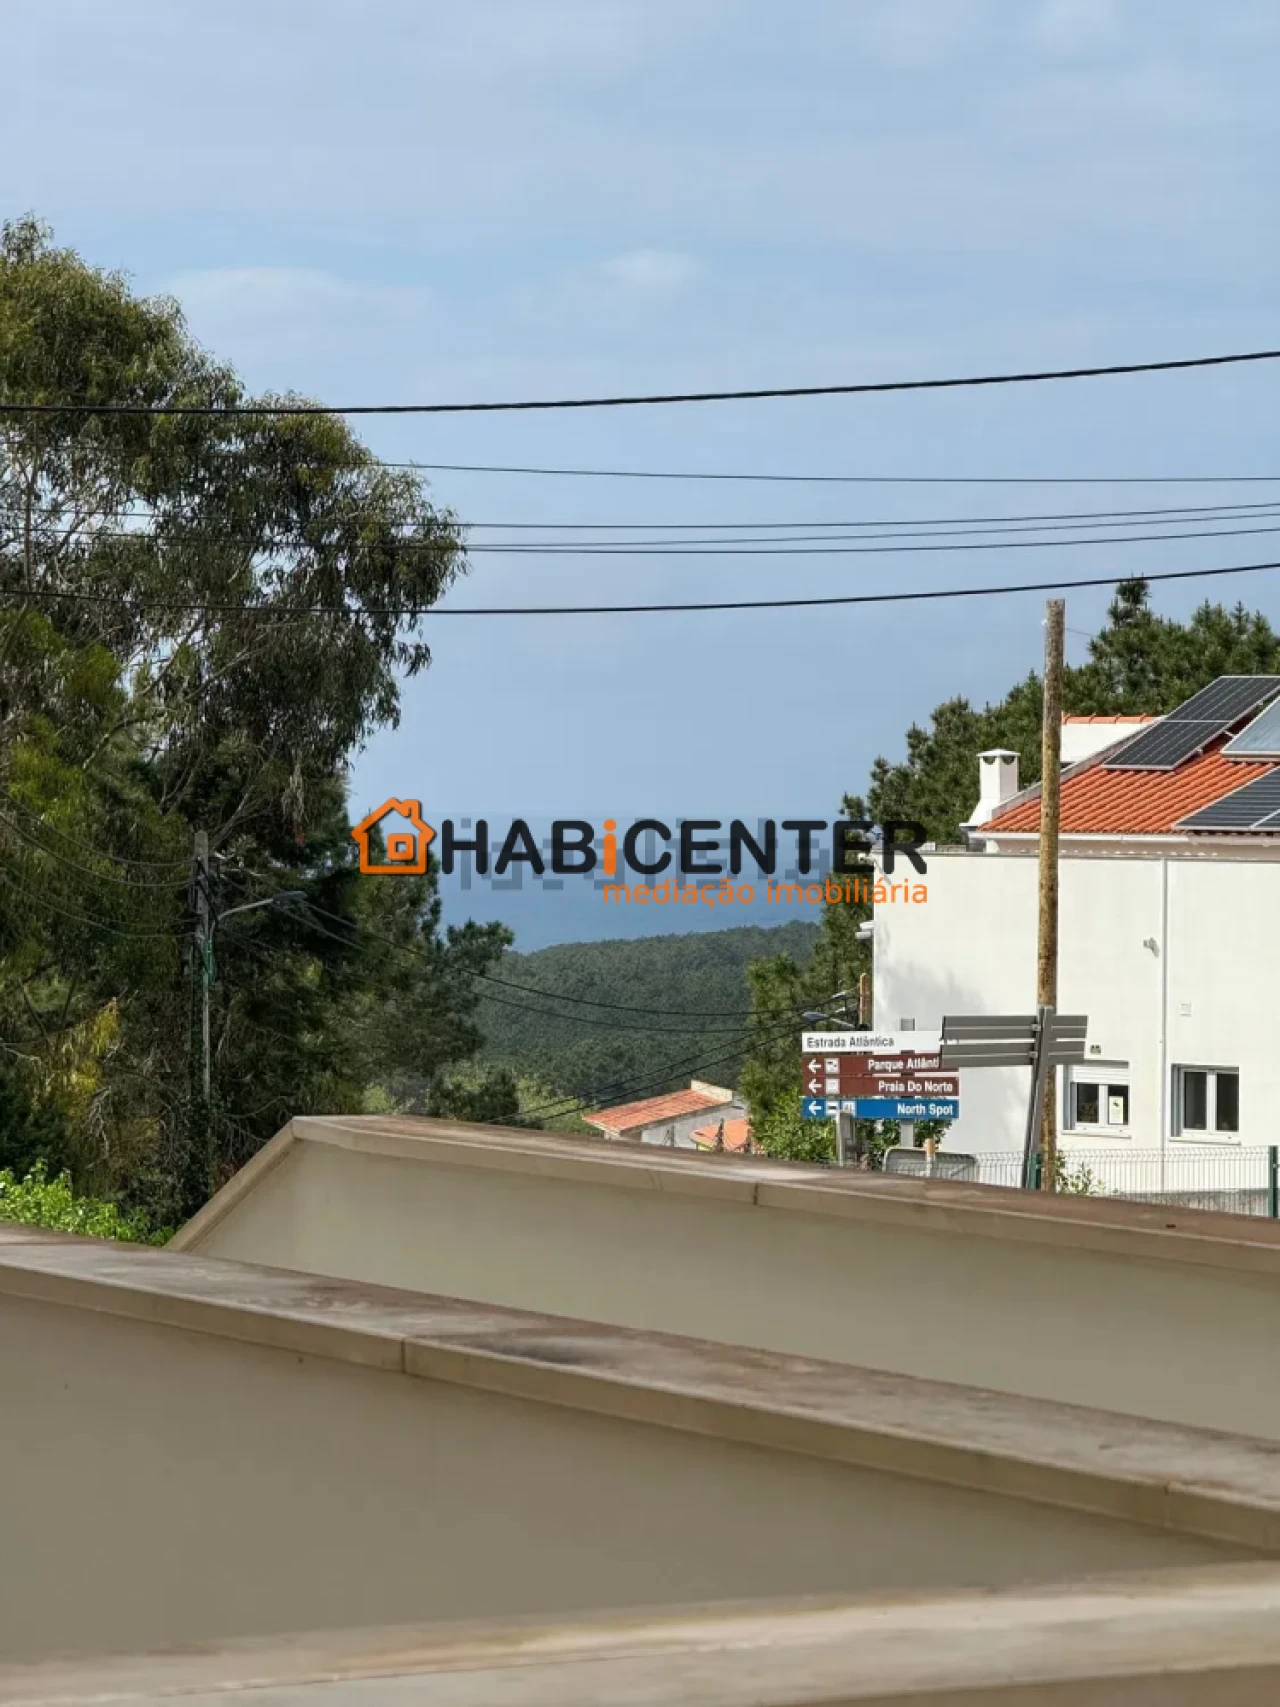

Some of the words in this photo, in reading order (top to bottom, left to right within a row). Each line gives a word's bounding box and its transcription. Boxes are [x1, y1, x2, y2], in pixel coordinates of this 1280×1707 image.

[807, 1037, 846, 1048] Estrada
[849, 1036, 894, 1047] Atlântica
[868, 1059, 904, 1072] Parque
[906, 1056, 939, 1069] Atlânti
[878, 1080, 905, 1092] Praia
[908, 1080, 921, 1092] Do
[925, 1080, 953, 1092] Norte
[897, 1103, 925, 1115] North
[928, 1103, 953, 1116] Spot
